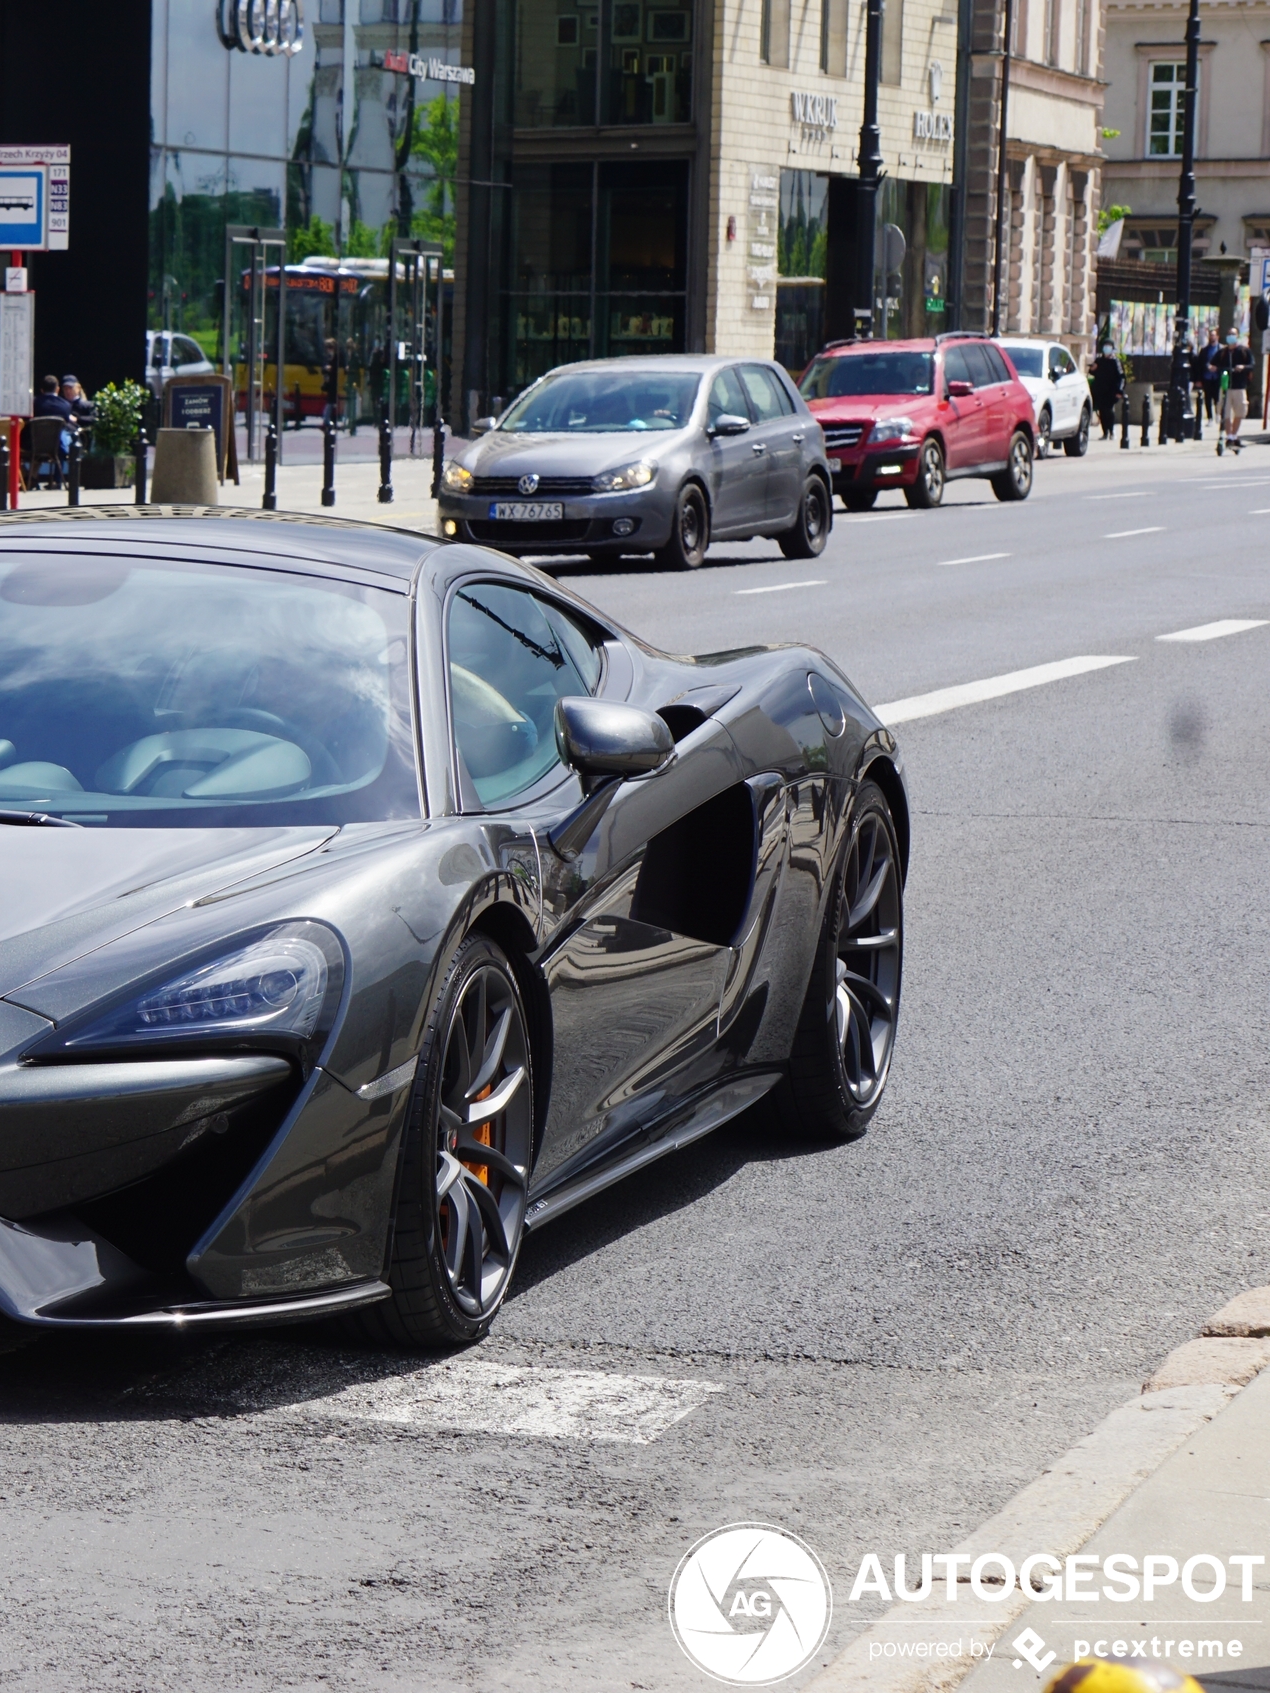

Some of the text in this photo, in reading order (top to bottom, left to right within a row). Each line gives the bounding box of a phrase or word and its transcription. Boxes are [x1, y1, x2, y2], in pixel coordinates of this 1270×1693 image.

[409, 53, 428, 82] City
[429, 58, 475, 84] Warszawa
[25, 150, 55, 160] Krzyży
[56, 150, 68, 158] 04
[53, 168, 67, 177] 171
[51, 184, 68, 194] N33
[51, 218, 66, 227] 901
[498, 504, 561, 518] WX 76765
